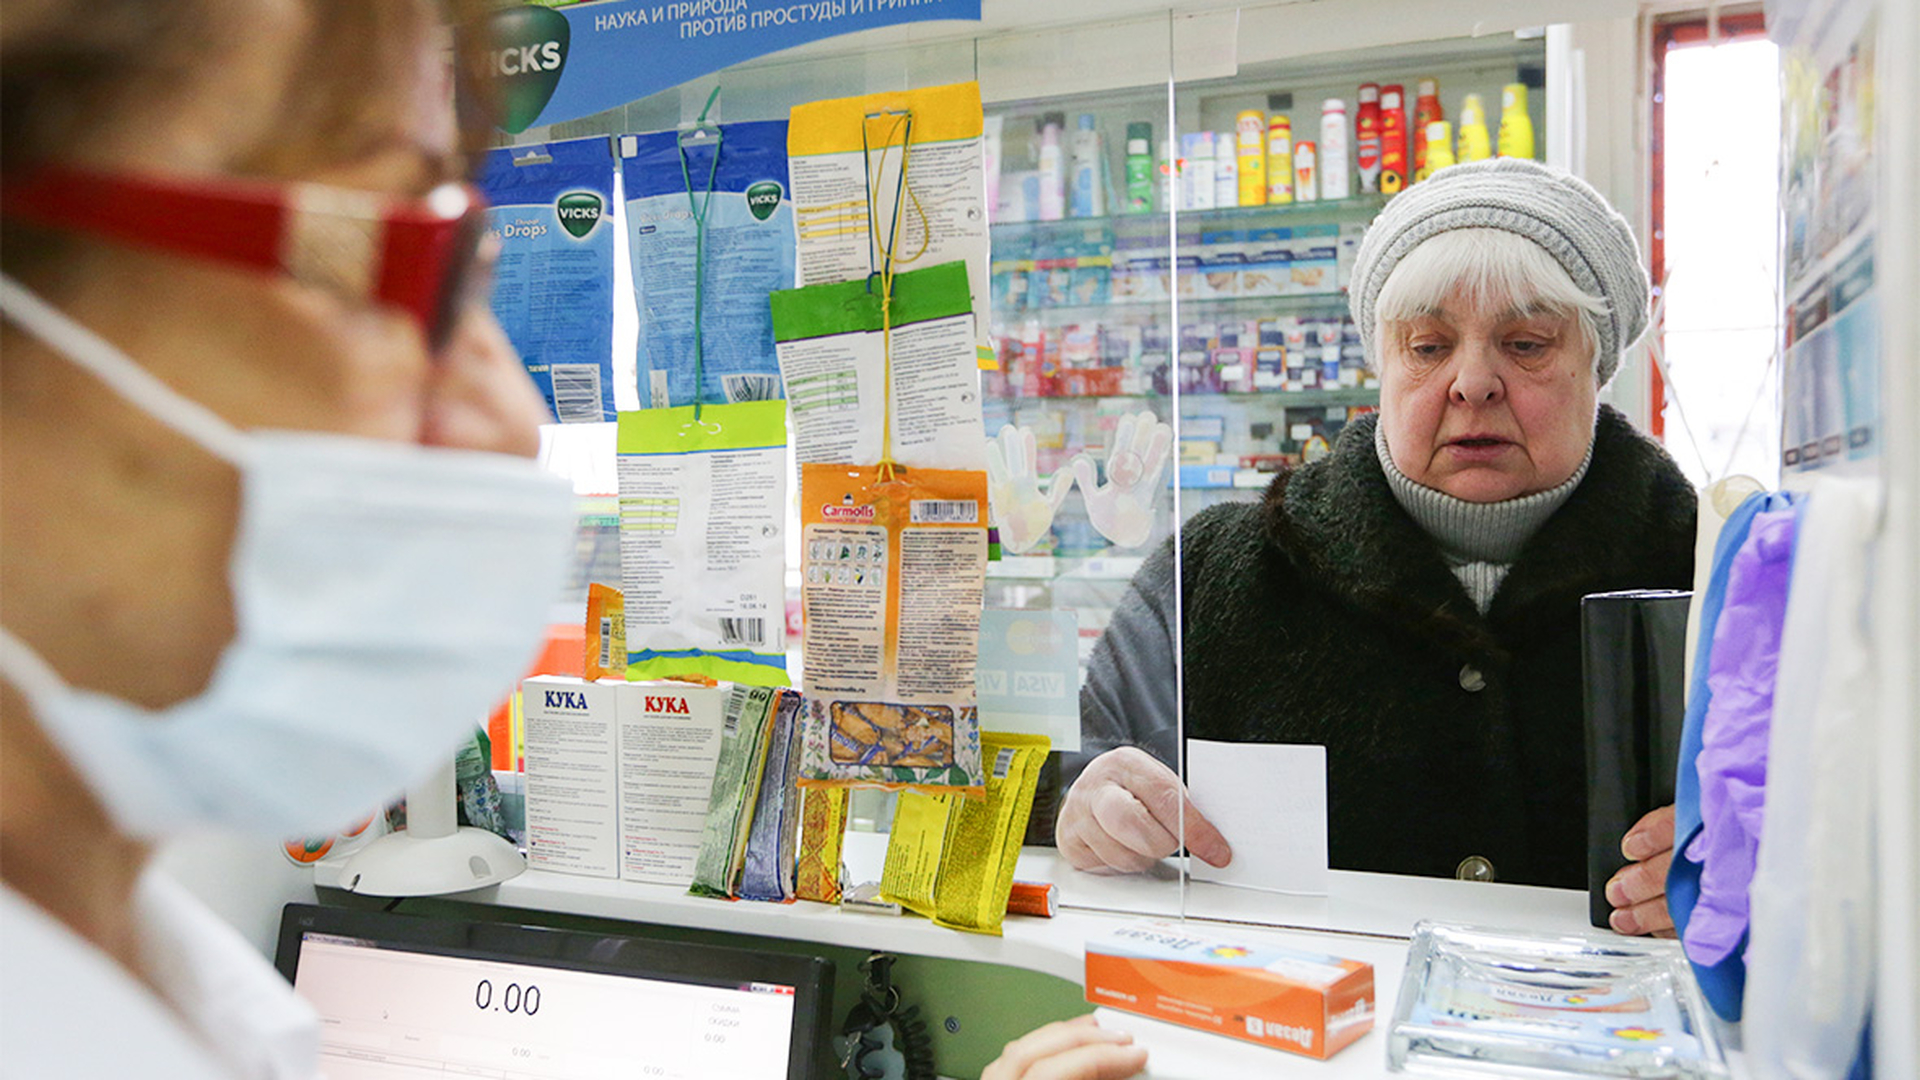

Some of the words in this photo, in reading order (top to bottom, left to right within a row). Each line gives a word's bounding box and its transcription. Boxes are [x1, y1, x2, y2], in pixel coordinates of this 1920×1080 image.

[595, 9, 648, 32] НАУКА
[652, 7, 663, 23] И
[668, 0, 747, 20] ПРИРОДА
[680, 14, 747, 39] ПРОТИВ
[751, 2, 846, 28] ПРОСТУДЫ
[486, 41, 562, 76] ICKS
[750, 194, 779, 206] VICKS
[559, 207, 600, 219] VICKS
[504, 223, 548, 240] Drops
[822, 504, 874, 519] Carmolis
[545, 691, 588, 709] КУКА
[645, 696, 690, 714] КУКА
[476, 979, 541, 1015] 0.00
